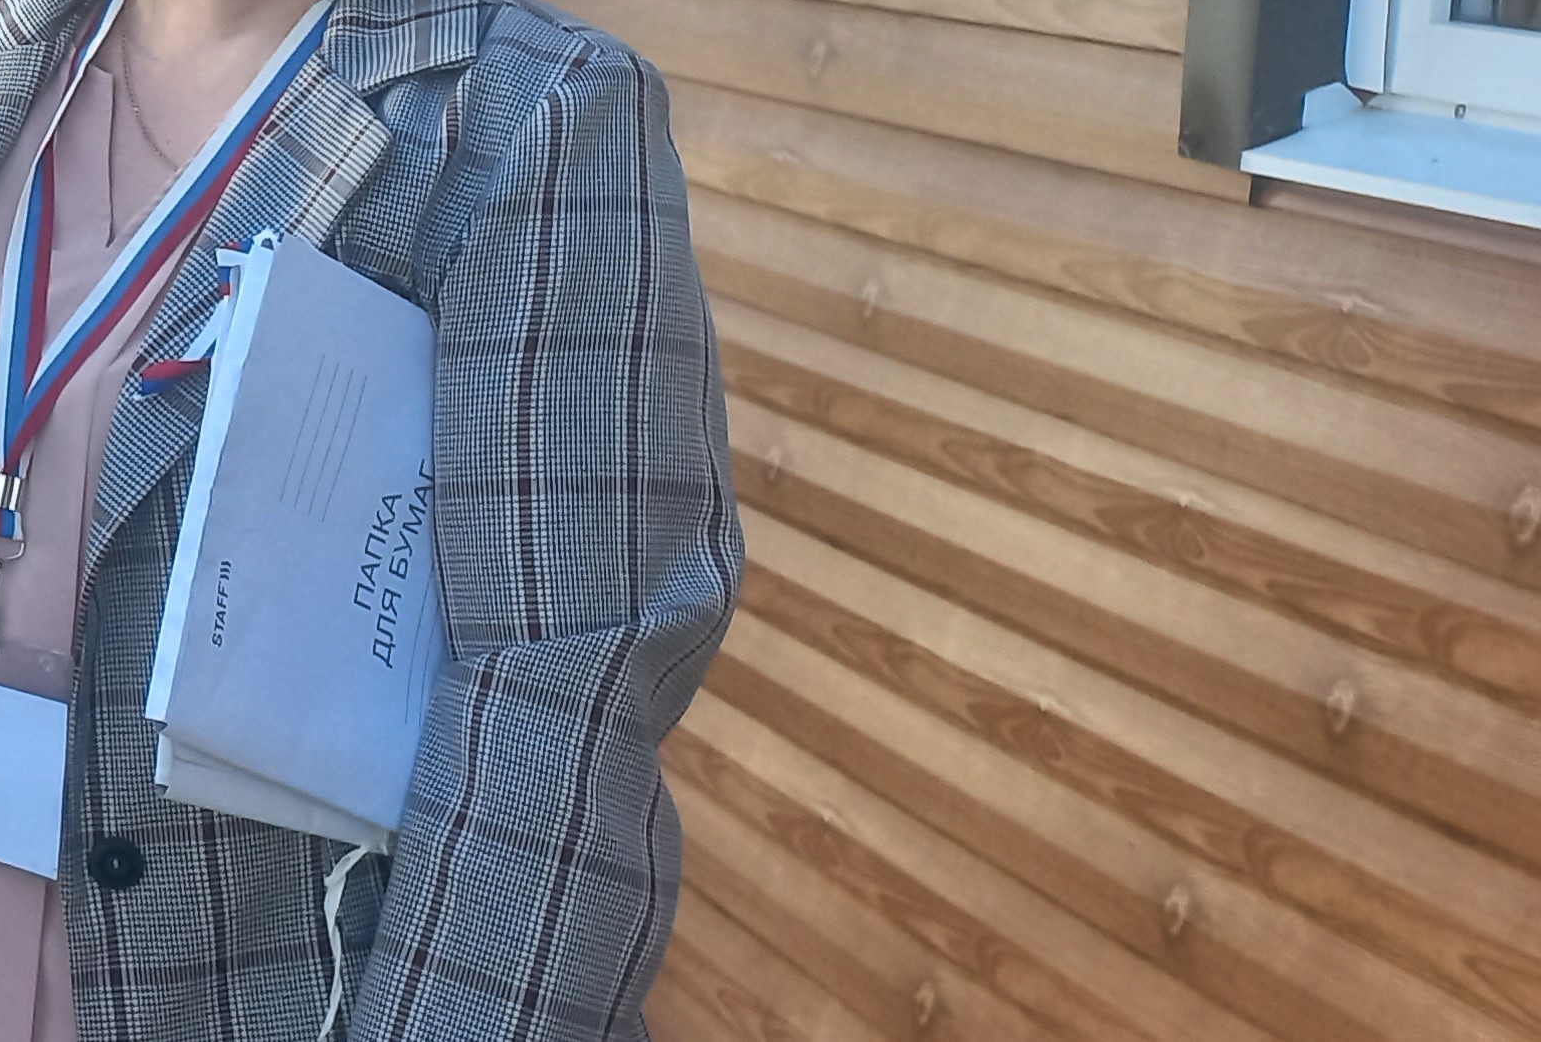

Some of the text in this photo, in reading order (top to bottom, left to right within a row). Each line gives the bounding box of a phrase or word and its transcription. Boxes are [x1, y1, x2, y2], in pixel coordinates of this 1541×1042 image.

[353, 493, 403, 611] ПАПКА
[372, 458, 434, 670] ДЛЯ БУМАГ
[211, 578, 229, 648] STAFF
